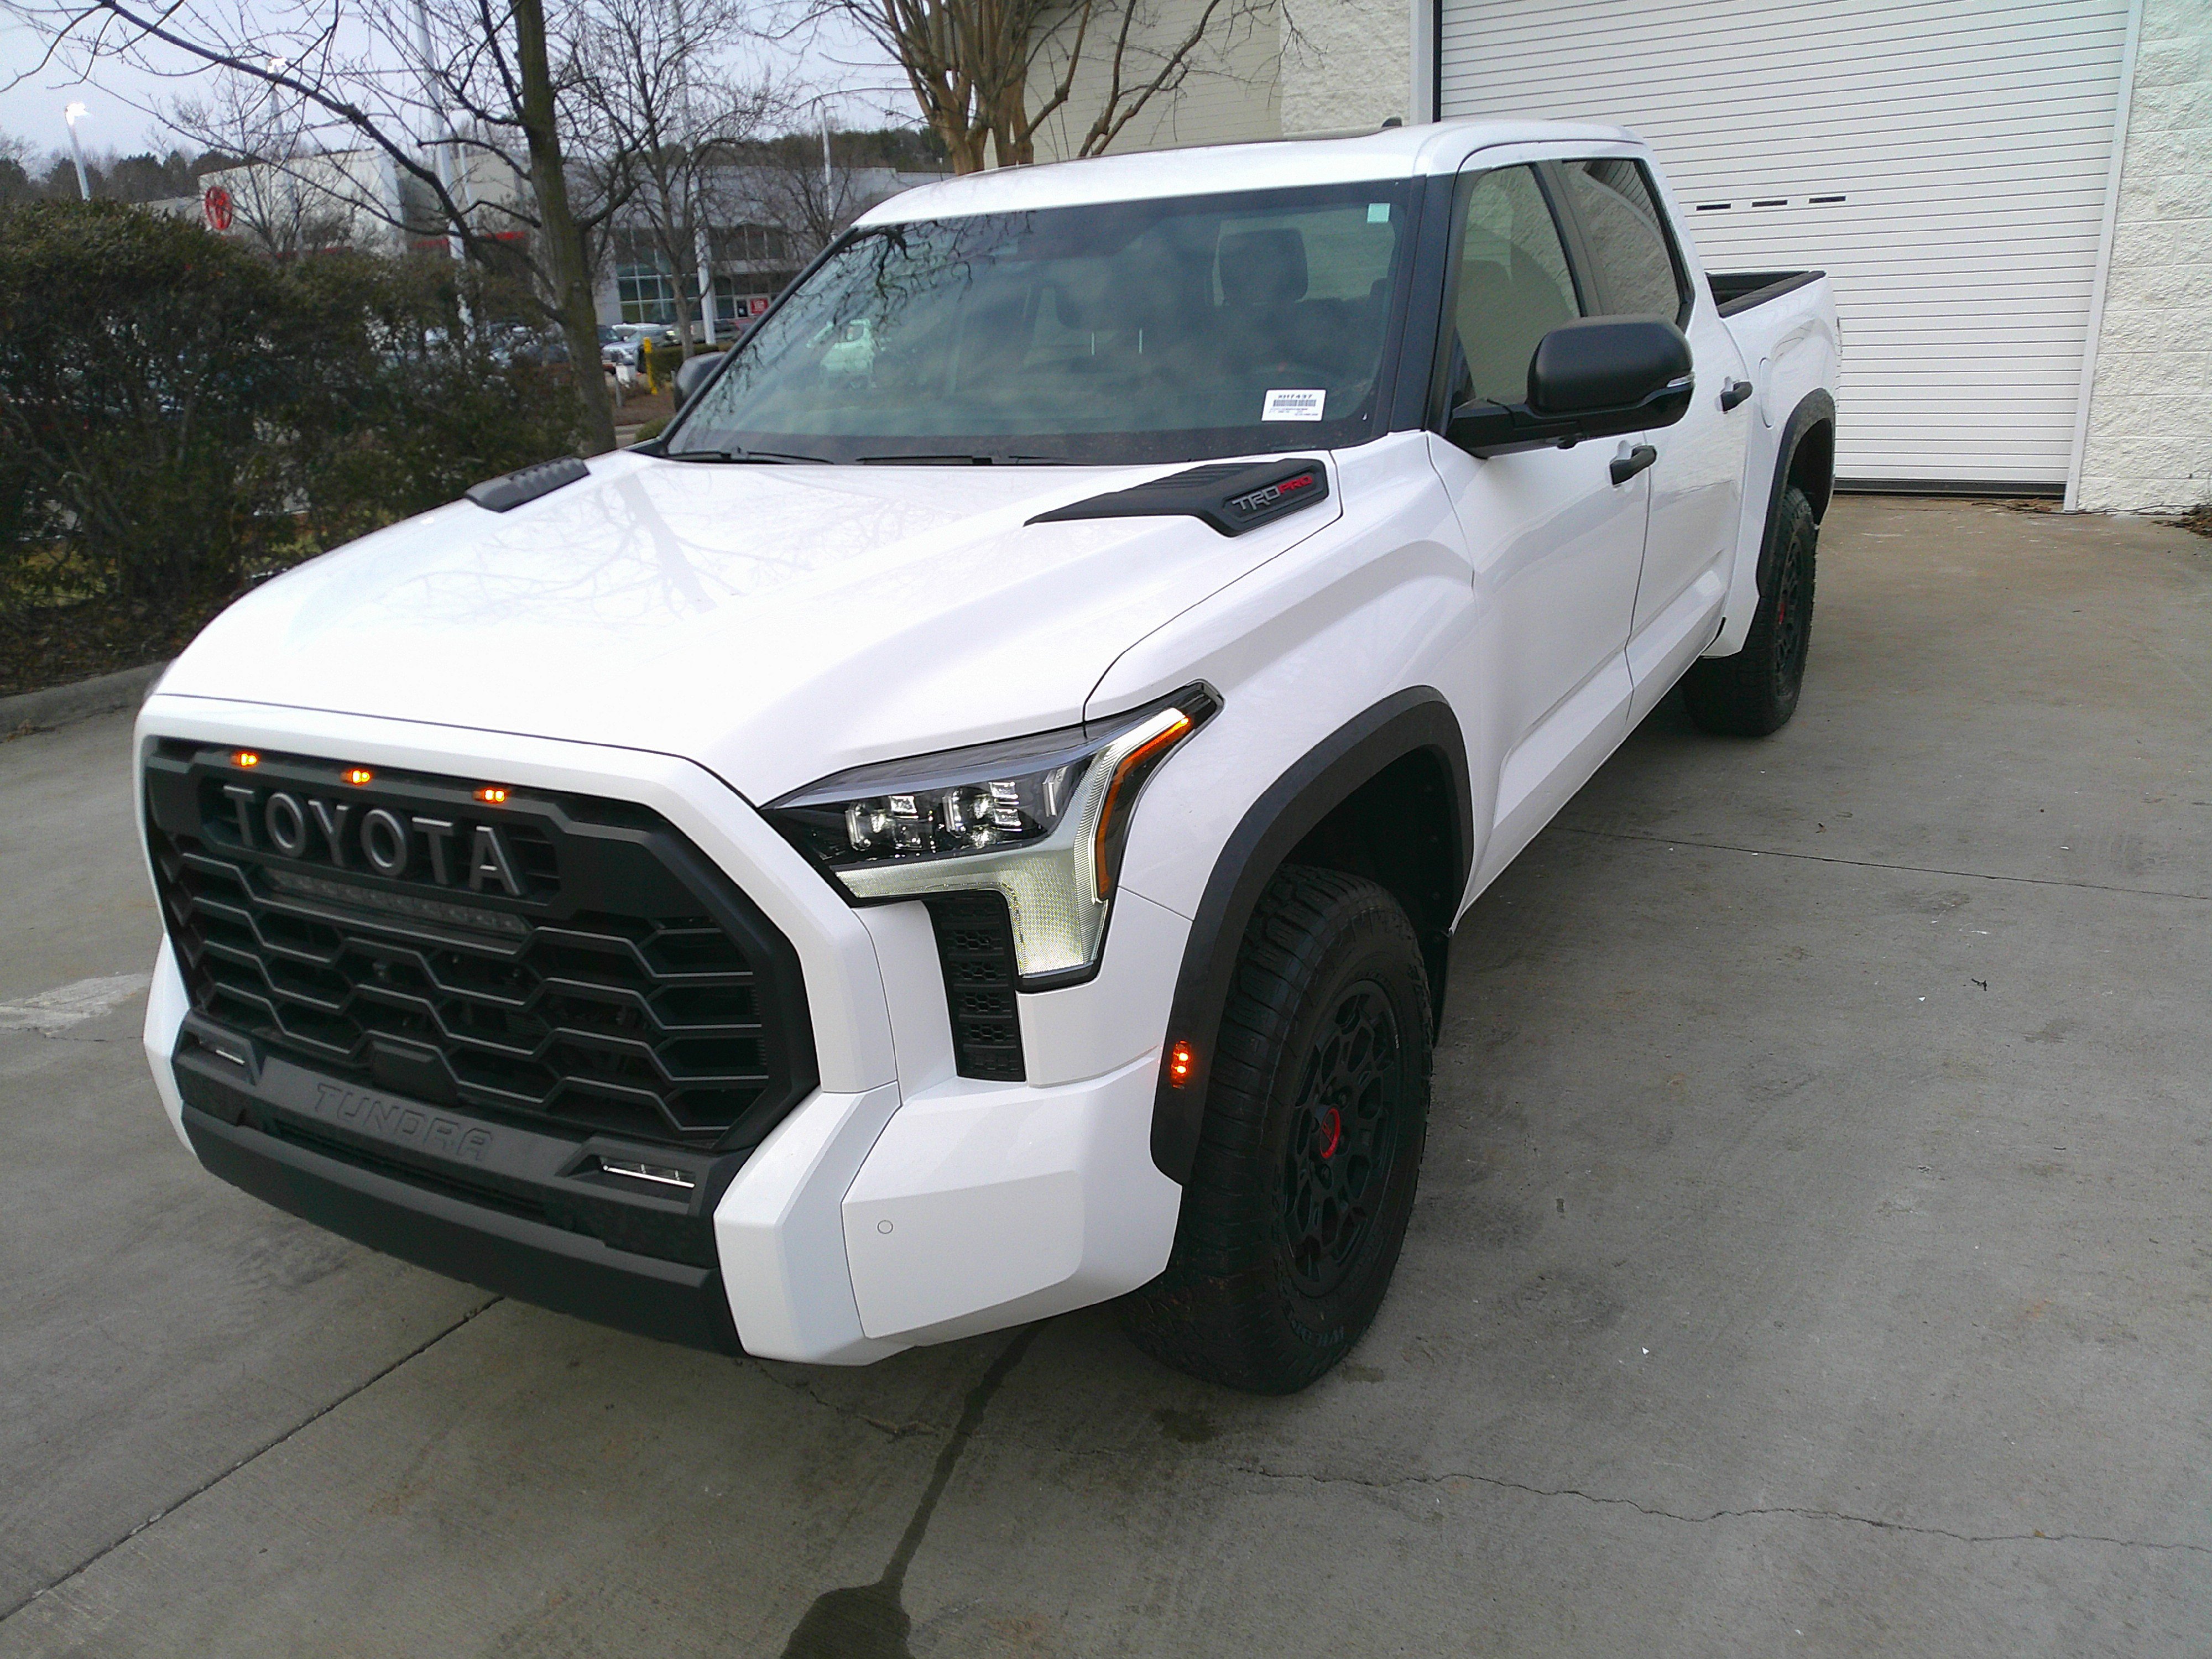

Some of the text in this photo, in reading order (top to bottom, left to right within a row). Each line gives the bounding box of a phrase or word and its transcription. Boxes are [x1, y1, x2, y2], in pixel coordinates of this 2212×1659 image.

[1232, 476, 1313, 510] TRD PRO
[223, 784, 521, 896] TOYOTA
[315, 1082, 494, 1161] TUNDRA
